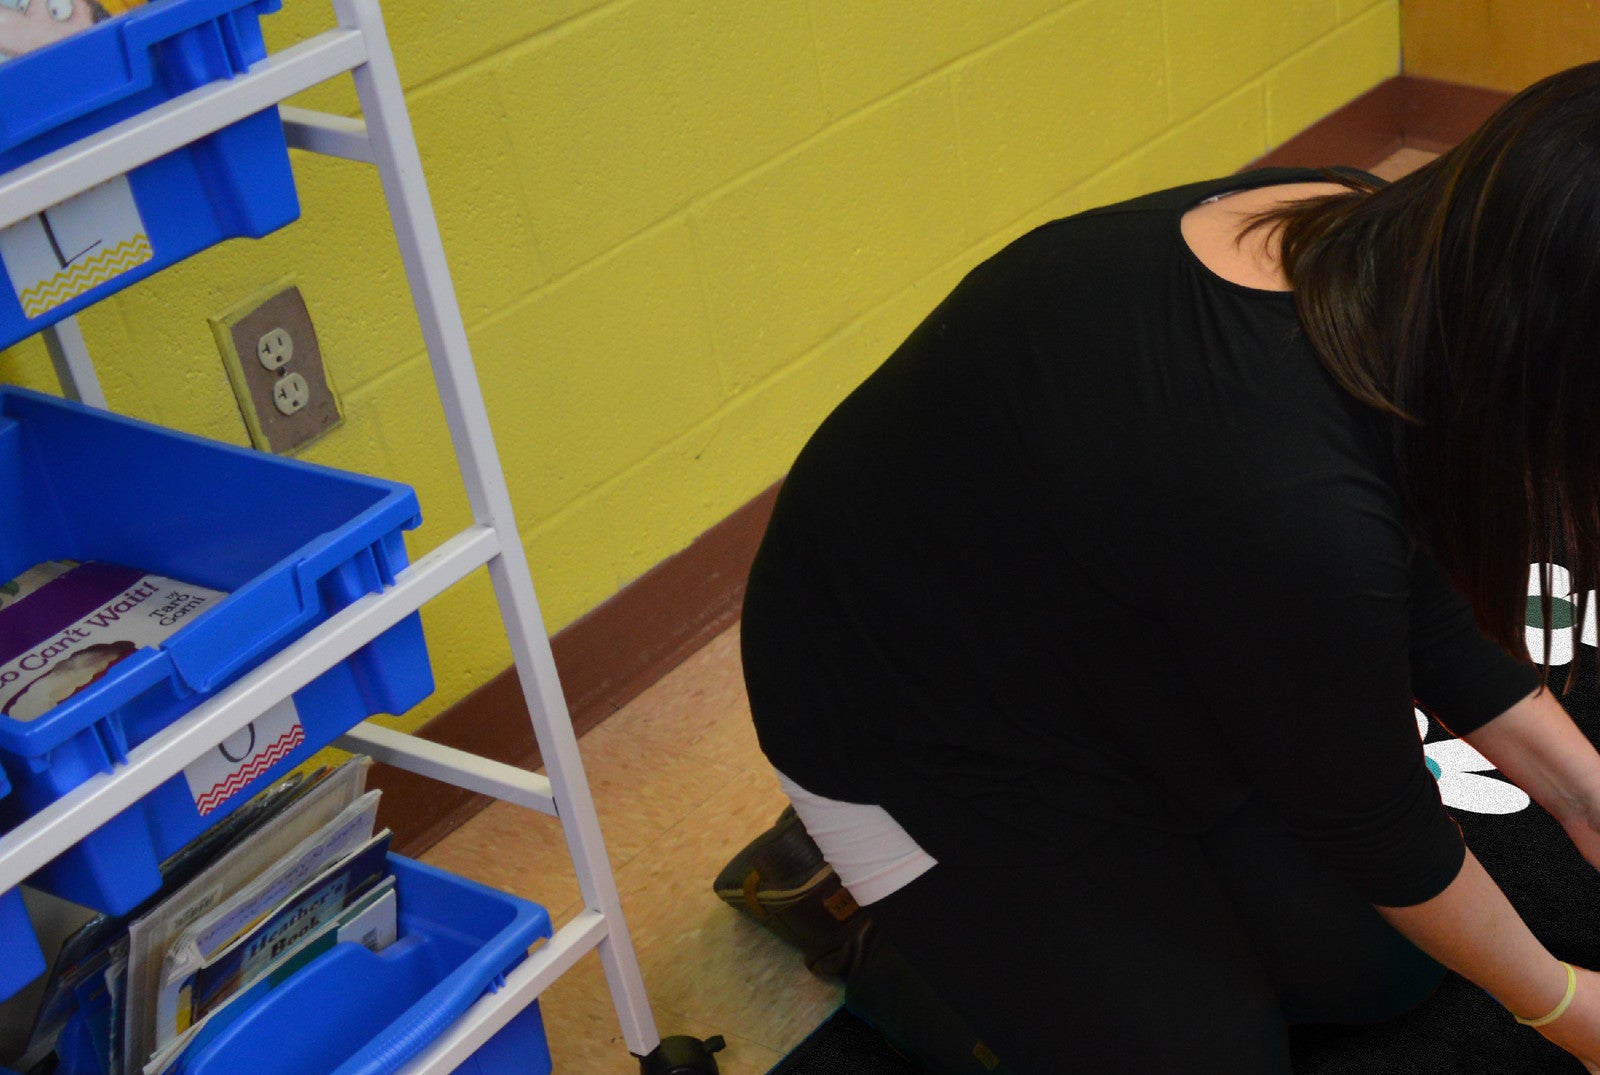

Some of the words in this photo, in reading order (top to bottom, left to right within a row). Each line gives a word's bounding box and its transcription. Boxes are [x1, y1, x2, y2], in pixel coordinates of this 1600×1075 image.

[149, 594, 190, 618] Taro
[159, 596, 206, 627] Gomi
[166, 590, 180, 600] by
[19, 626, 92, 671] Can't
[87, 581, 160, 628] Wait!
[249, 883, 344, 957] Heather's
[270, 916, 320, 958] Book
